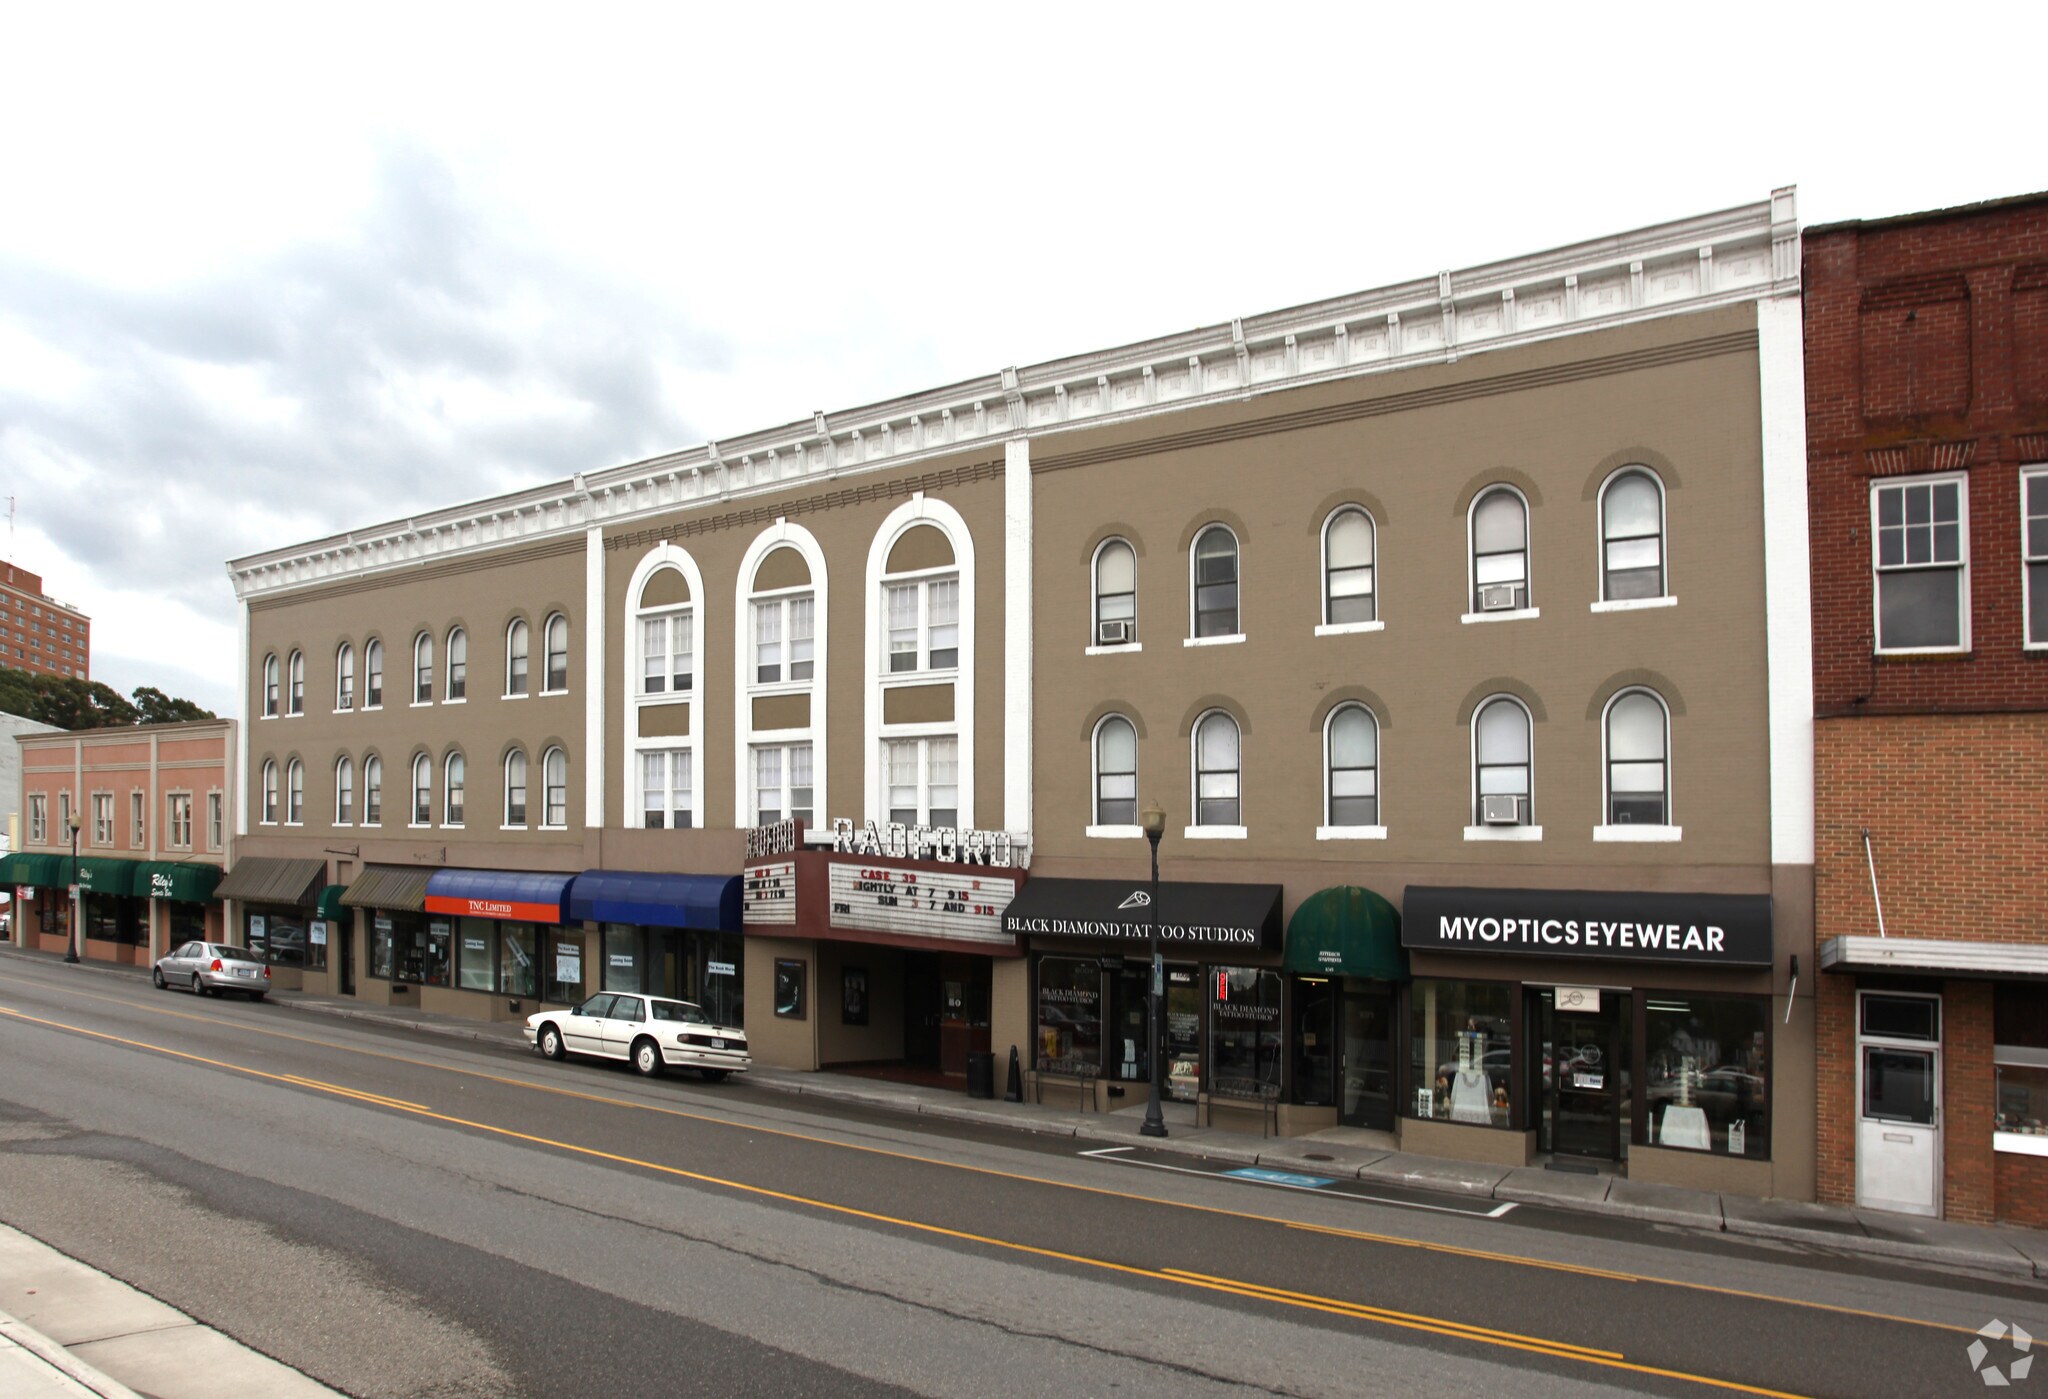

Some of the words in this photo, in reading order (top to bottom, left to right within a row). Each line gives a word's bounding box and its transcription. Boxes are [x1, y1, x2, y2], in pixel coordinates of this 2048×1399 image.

[746, 818, 794, 859] RADFORD
[833, 817, 1012, 868] RADFORD
[152, 873, 173, 888] Riley's
[861, 869, 890, 881] CASE
[902, 873, 916, 884] 39
[853, 880, 896, 894] NIGHTLY
[905, 886, 919, 897] AT
[928, 888, 935, 898] 7
[469, 900, 484, 911] TNC
[485, 902, 512, 913] LIMITED
[834, 903, 850, 914] FRI
[878, 895, 898, 907] SUN
[912, 899, 919, 909] 3
[929, 901, 936, 911] 7
[943, 902, 965, 914] AND
[1007, 917, 1050, 932] BLACK
[1053, 919, 1120, 936] DIAMOND
[1122, 922, 1185, 939] TATOO
[1188, 925, 1255, 943] STUDIOS
[1440, 916, 1579, 945] MYOPTICS
[1585, 921, 1724, 952] EYEWEAR
[1042, 987, 1064, 997] BLACK
[1065, 989, 1098, 999] DIAMOND
[1213, 1003, 1238, 1012] BLACK
[1240, 1005, 1278, 1015] DIAMOND
[1220, 1010, 1244, 1018] TATTOO
[1245, 1012, 1273, 1021] STUDIOS
